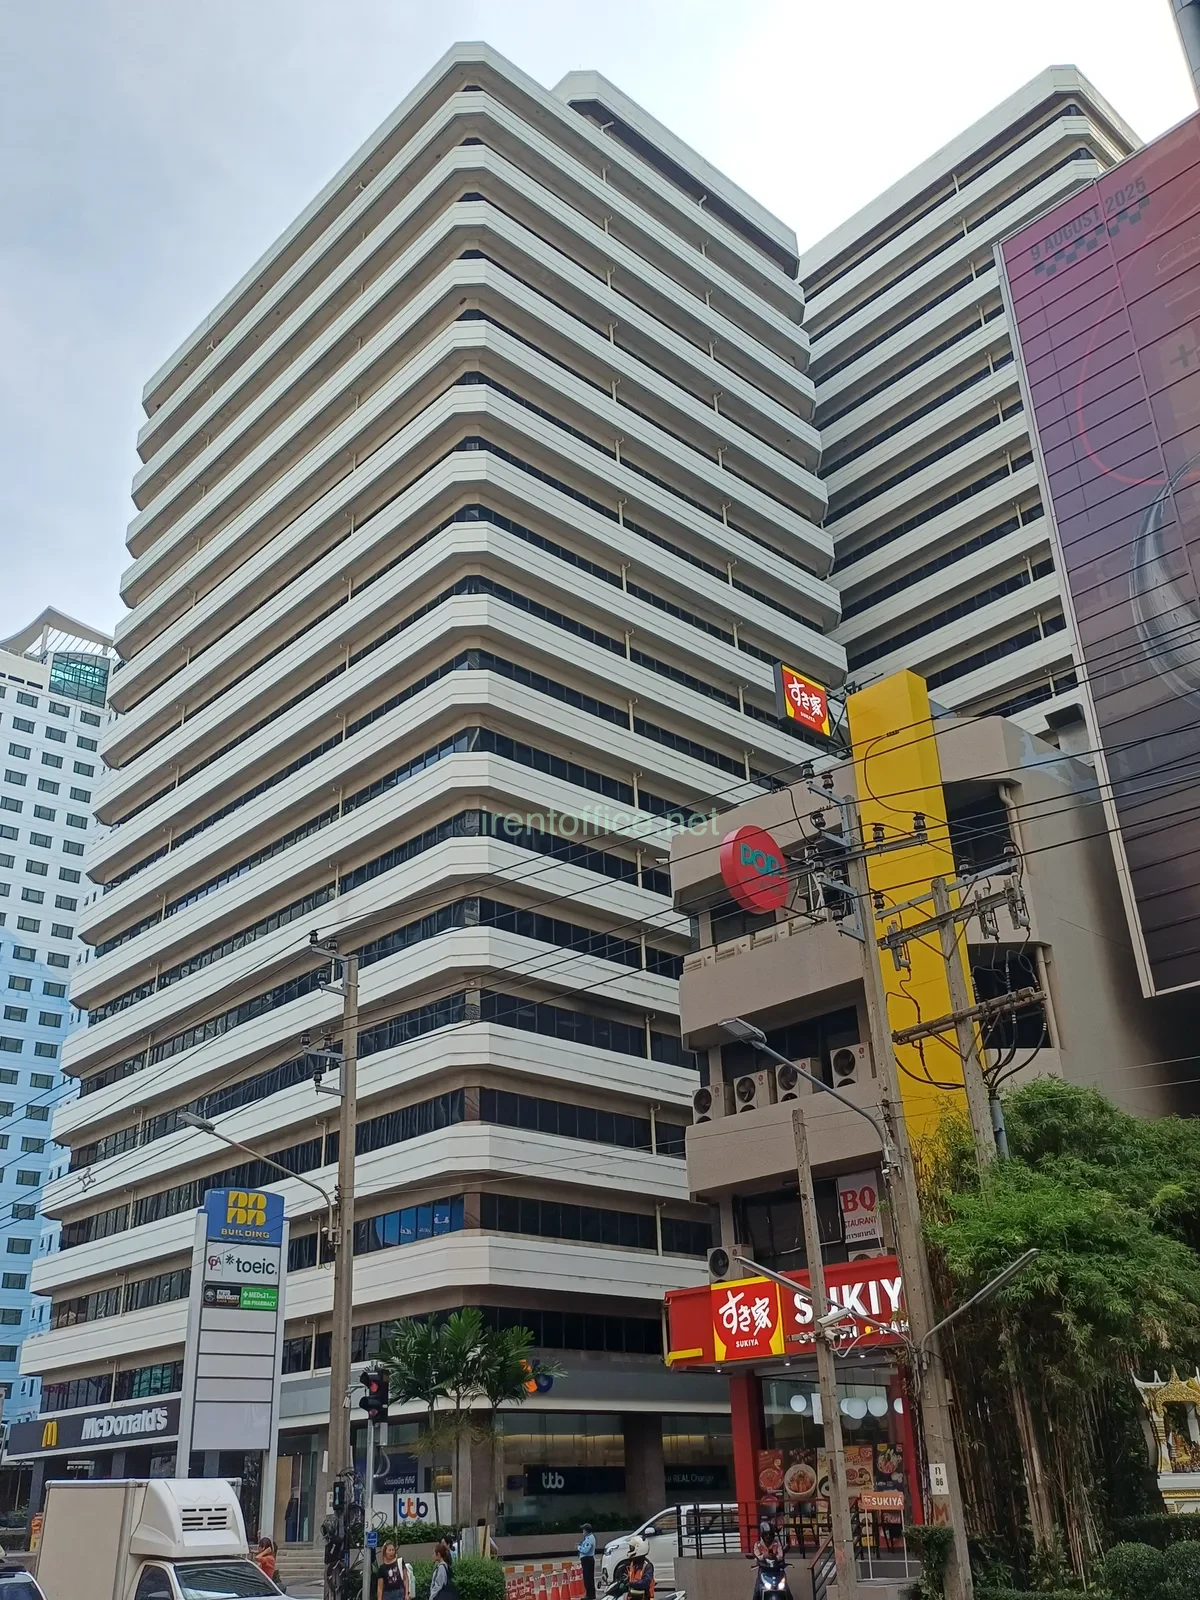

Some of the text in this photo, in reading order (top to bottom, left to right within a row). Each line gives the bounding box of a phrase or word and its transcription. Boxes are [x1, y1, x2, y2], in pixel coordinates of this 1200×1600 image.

[1030, 176, 1146, 260] 9 AUGUST 2025
[788, 676, 824, 718] すき家
[221, 1228, 270, 1239] BUILDING
[718, 1290, 772, 1337] すき家
[735, 1339, 759, 1348] SUKIYA
[81, 1406, 168, 1440] McDonald's
[541, 1471, 565, 1489] ttb
[672, 1473, 690, 1483] REAL
[398, 1497, 429, 1519] ttb
[871, 1496, 904, 1506] SUKIYA
